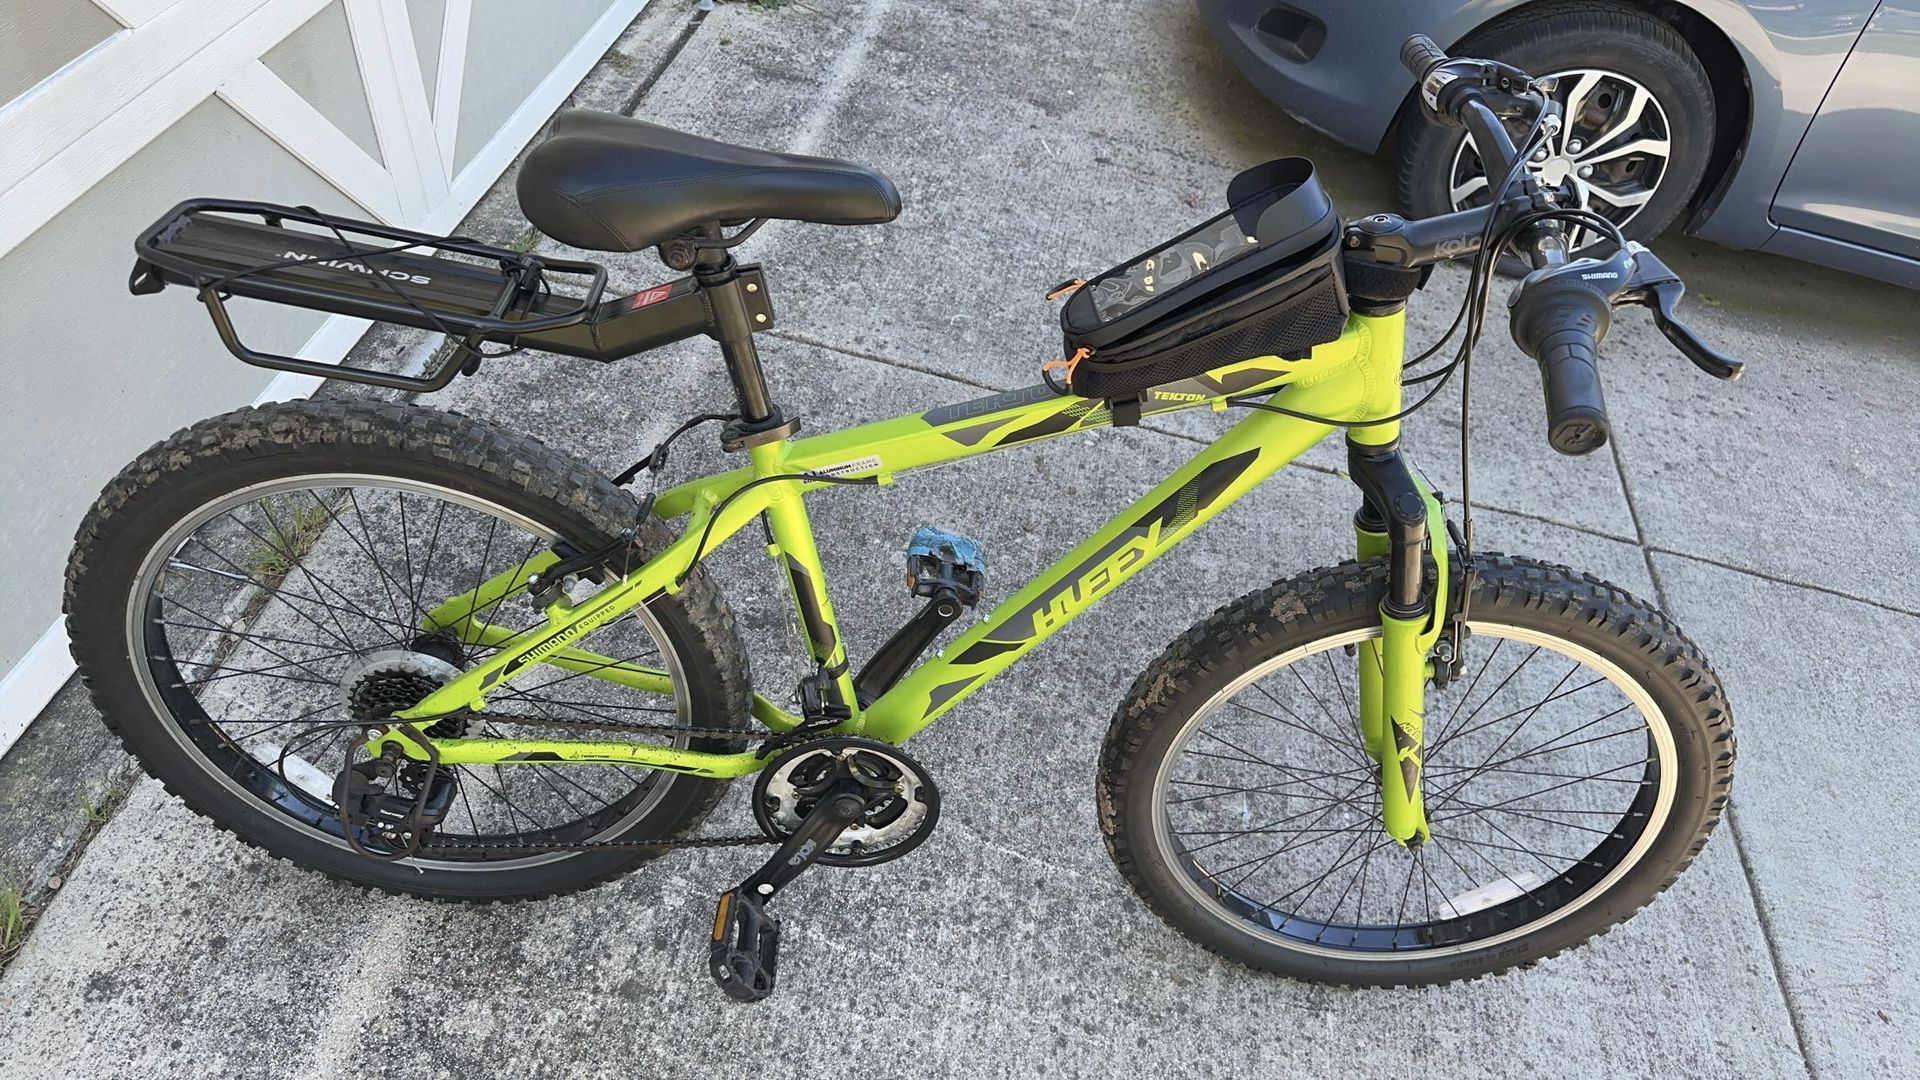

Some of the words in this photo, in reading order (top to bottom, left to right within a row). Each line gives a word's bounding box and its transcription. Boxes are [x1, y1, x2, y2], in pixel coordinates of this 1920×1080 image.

[1581, 272, 1618, 280] SHIMANO
[945, 384, 1056, 419] TEKTO
[1154, 391, 1206, 401] TEKTON
[819, 464, 851, 475] ALUMINUM
[821, 463, 879, 477] ONSTRUCTION
[1032, 516, 1163, 637] HUFFY
[518, 628, 576, 664] SHIMANO
[579, 605, 615, 629] EQUIPPED
